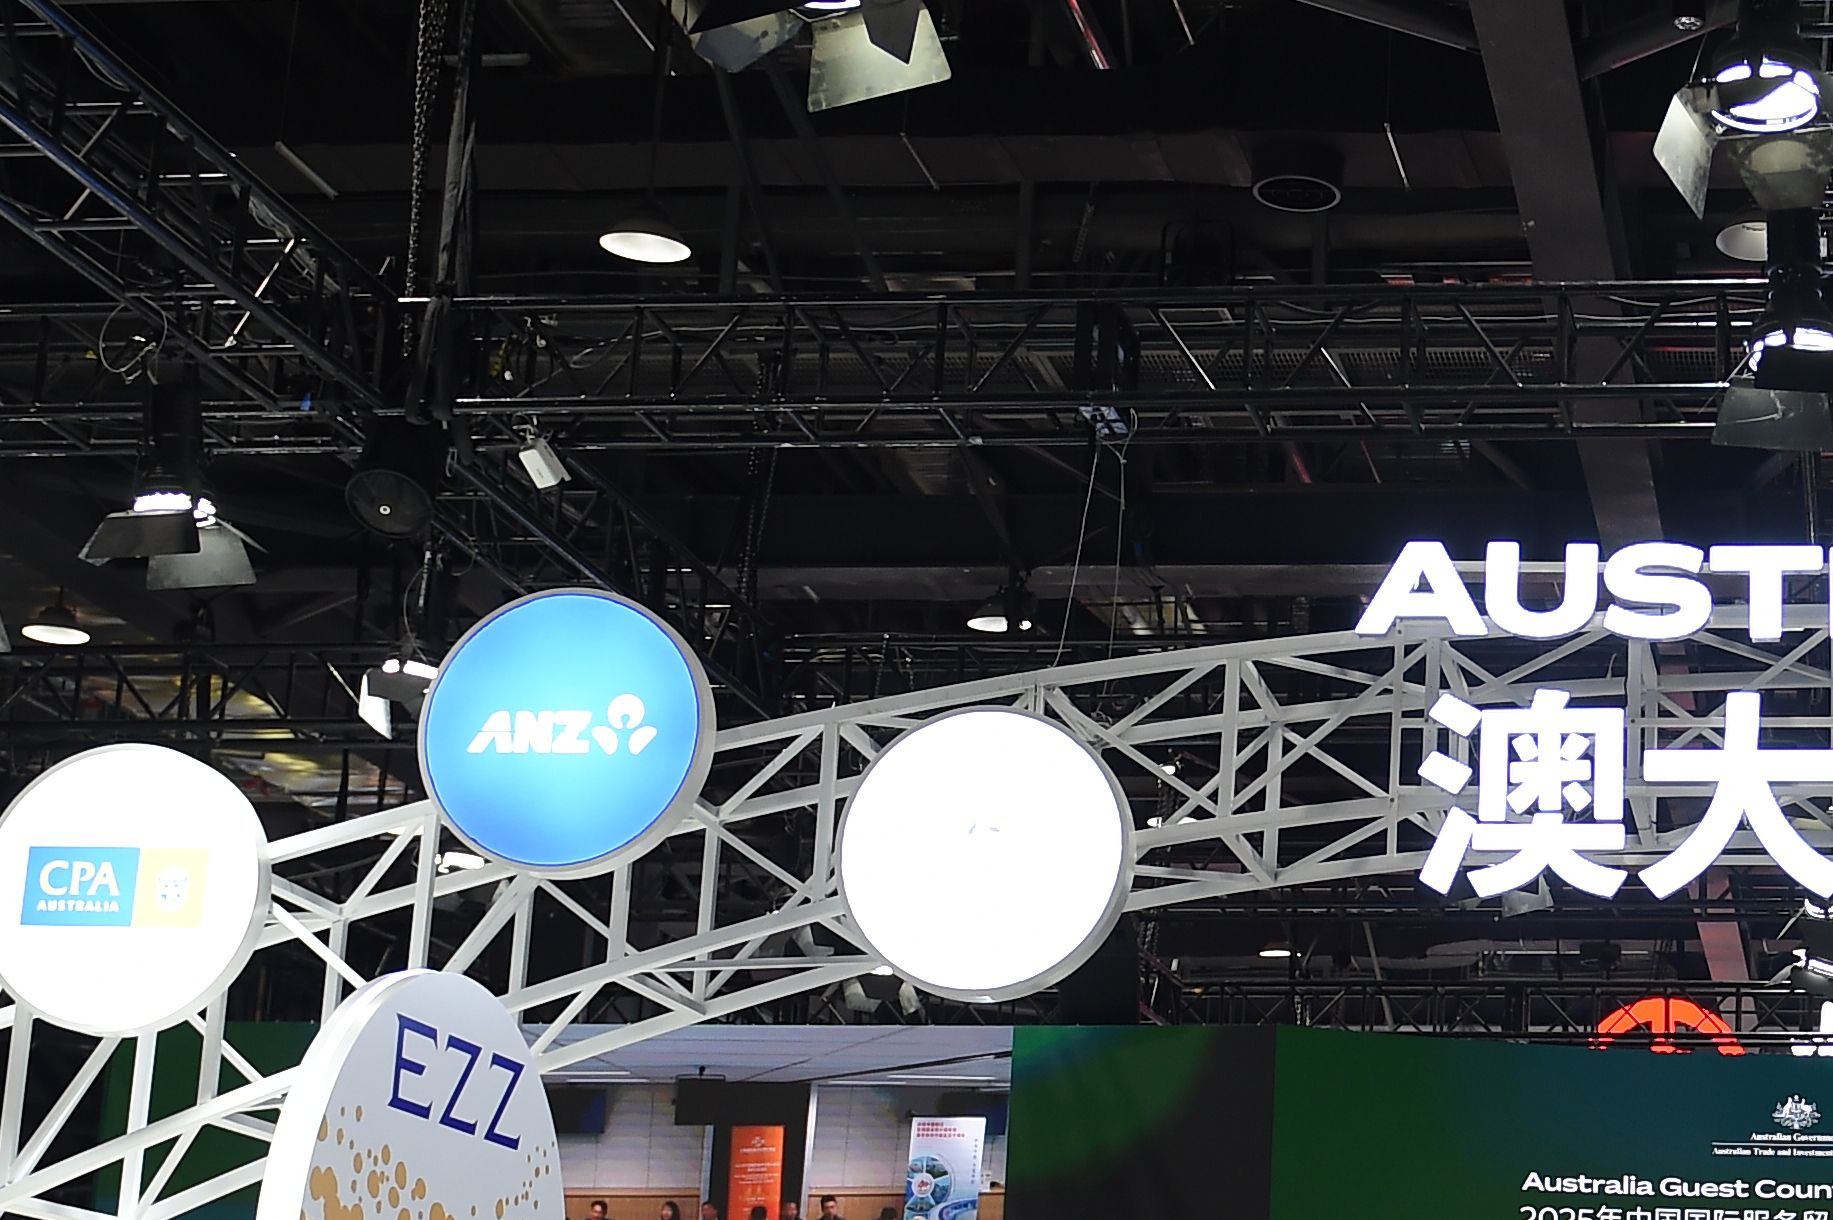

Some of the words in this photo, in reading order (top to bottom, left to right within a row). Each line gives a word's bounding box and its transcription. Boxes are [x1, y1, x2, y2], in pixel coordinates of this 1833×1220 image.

[467, 709, 592, 754] ANZ
[39, 859, 120, 896] CPA
[37, 899, 120, 913] AUSTRALIA
[387, 1012, 525, 1151] EZZ
[1521, 1171, 1656, 1196] Australia
[1660, 1177, 1750, 1198] Guest
